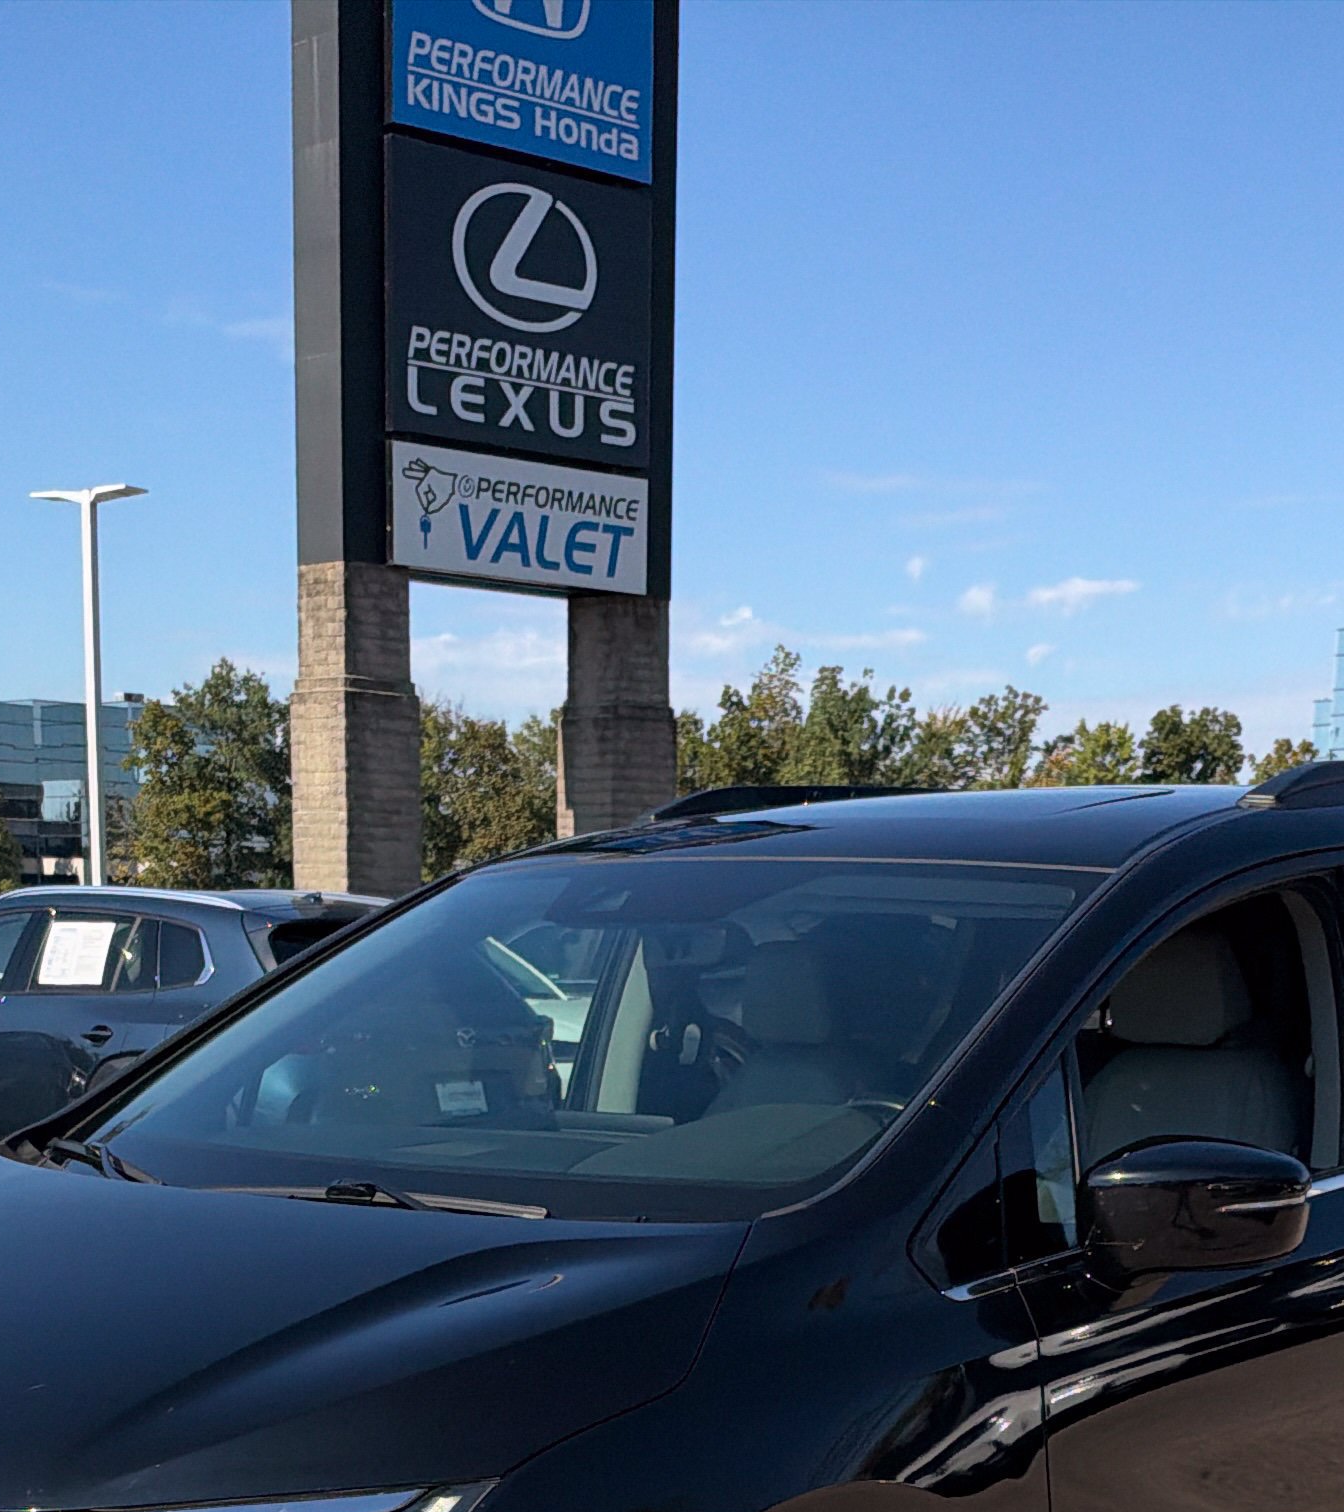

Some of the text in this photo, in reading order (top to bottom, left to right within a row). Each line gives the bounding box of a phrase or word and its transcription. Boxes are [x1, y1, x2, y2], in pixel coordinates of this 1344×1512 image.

[407, 30, 641, 122] PERFORMANCE
[407, 74, 640, 161] KINGS Honda
[407, 324, 635, 397] PERFORMANCE
[407, 365, 637, 447] LEXUS
[475, 476, 641, 522] PERFORMANCE
[458, 502, 635, 578] VALET
